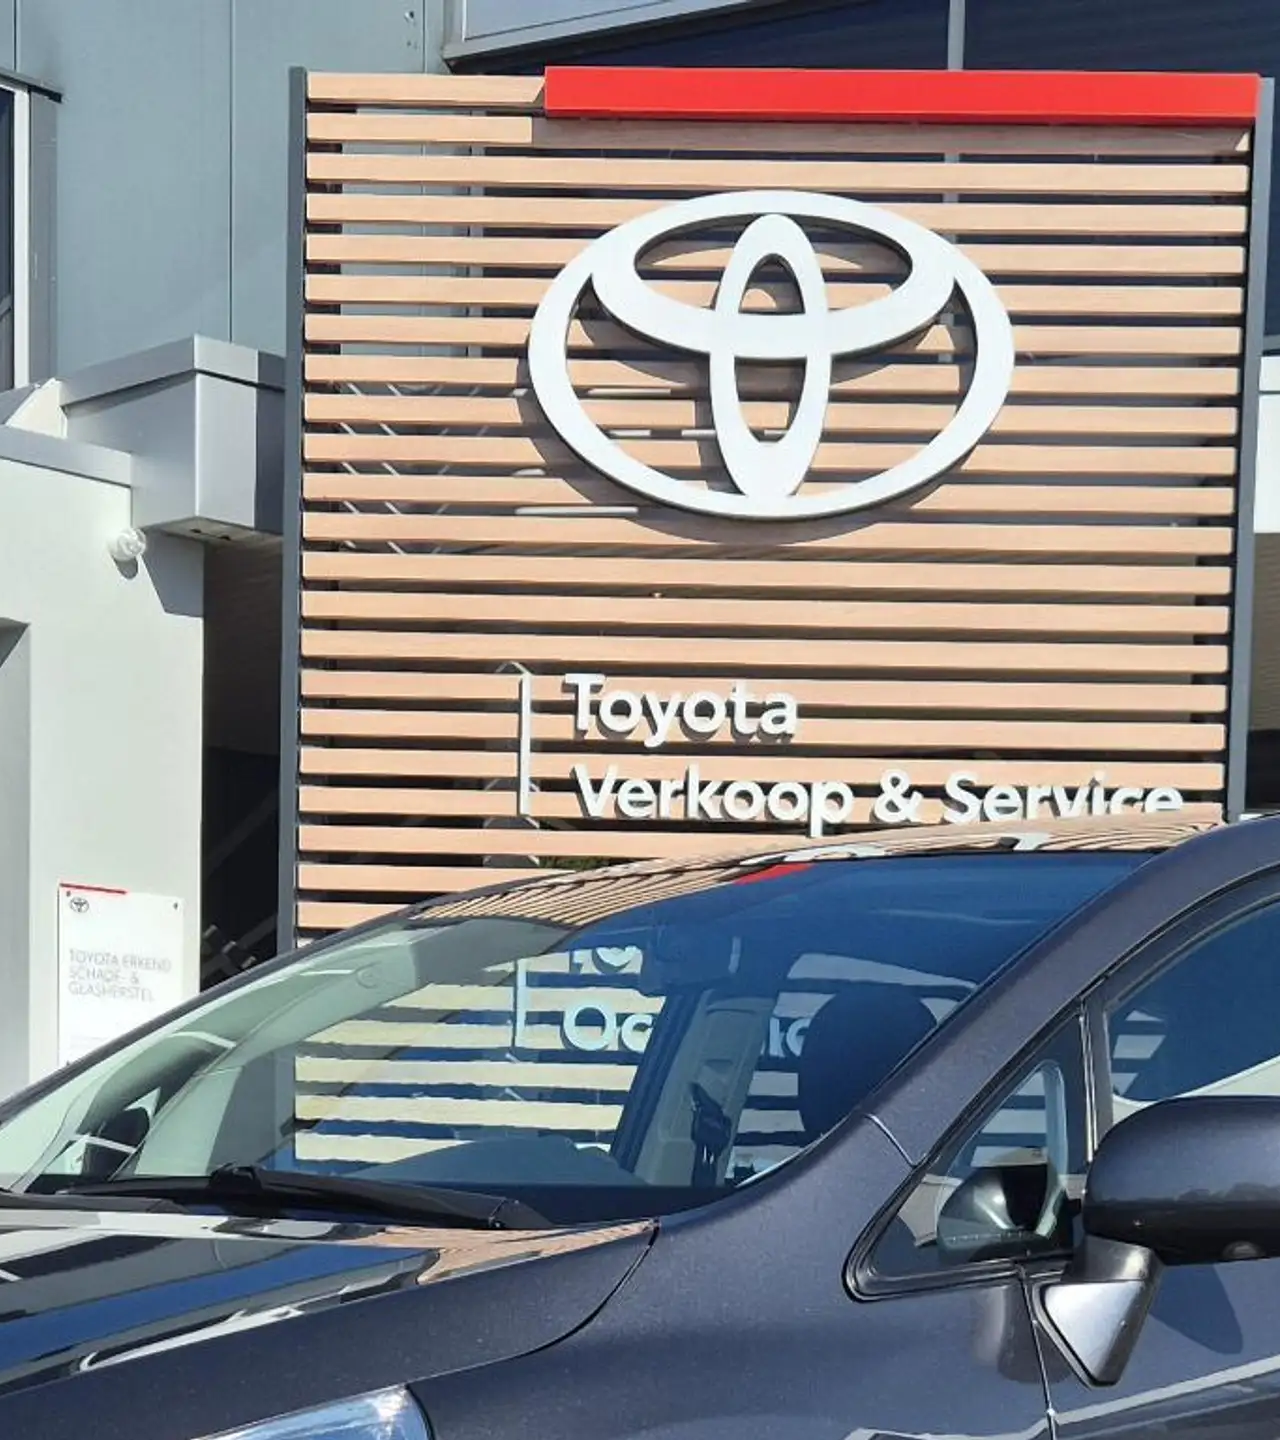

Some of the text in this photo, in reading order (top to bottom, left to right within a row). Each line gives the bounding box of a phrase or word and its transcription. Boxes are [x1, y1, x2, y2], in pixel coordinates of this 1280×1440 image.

[563, 673, 798, 747] Toyota
[572, 763, 1184, 838] Verkoop & Service
[69, 949, 119, 966] TOYOTA
